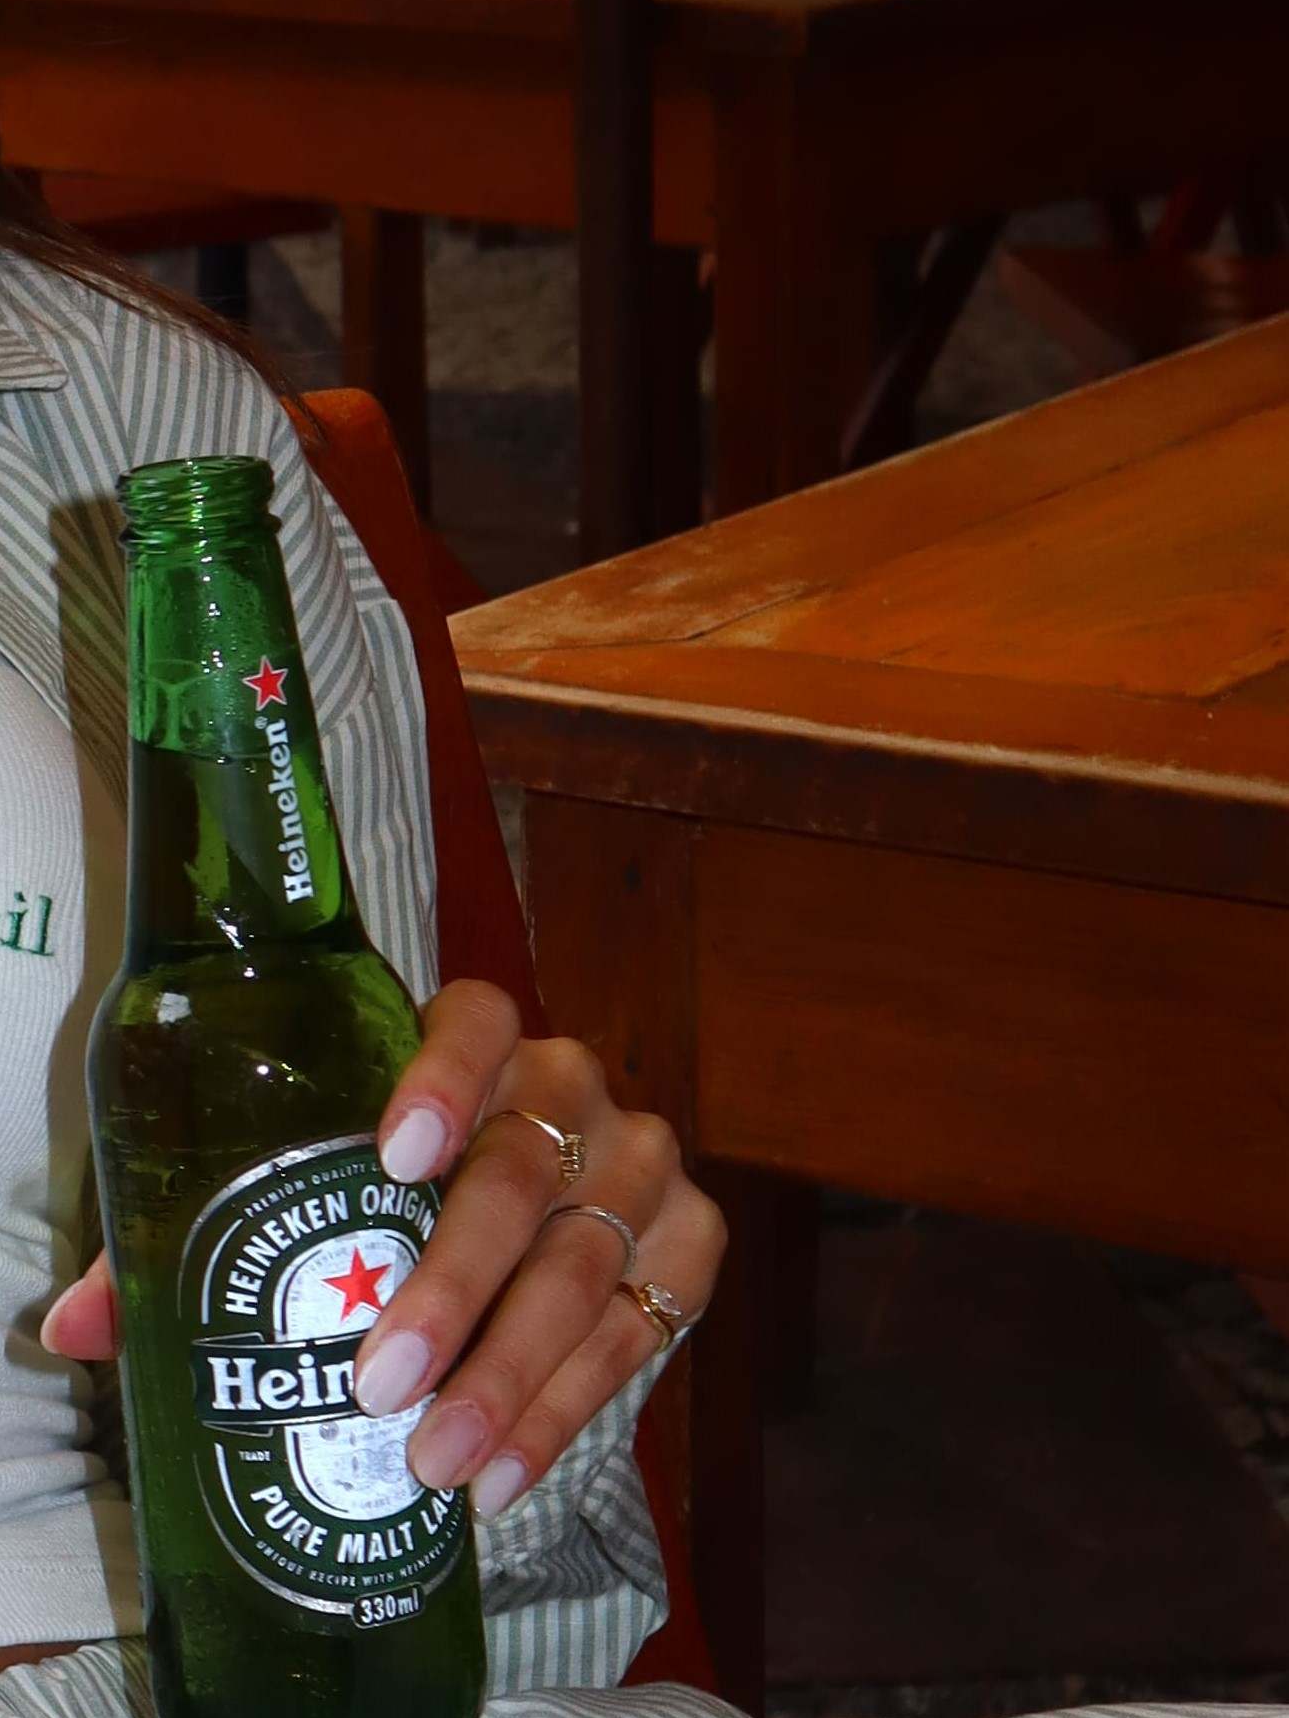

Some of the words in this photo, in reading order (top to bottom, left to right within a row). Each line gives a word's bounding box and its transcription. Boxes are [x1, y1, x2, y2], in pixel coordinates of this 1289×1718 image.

[265, 717, 315, 905] Heineken
[224, 1190, 350, 1316] HEINEKEN
[249, 1484, 328, 1558] PURE
[336, 1520, 415, 1564] MALT
[359, 1587, 421, 1625] 330ml
